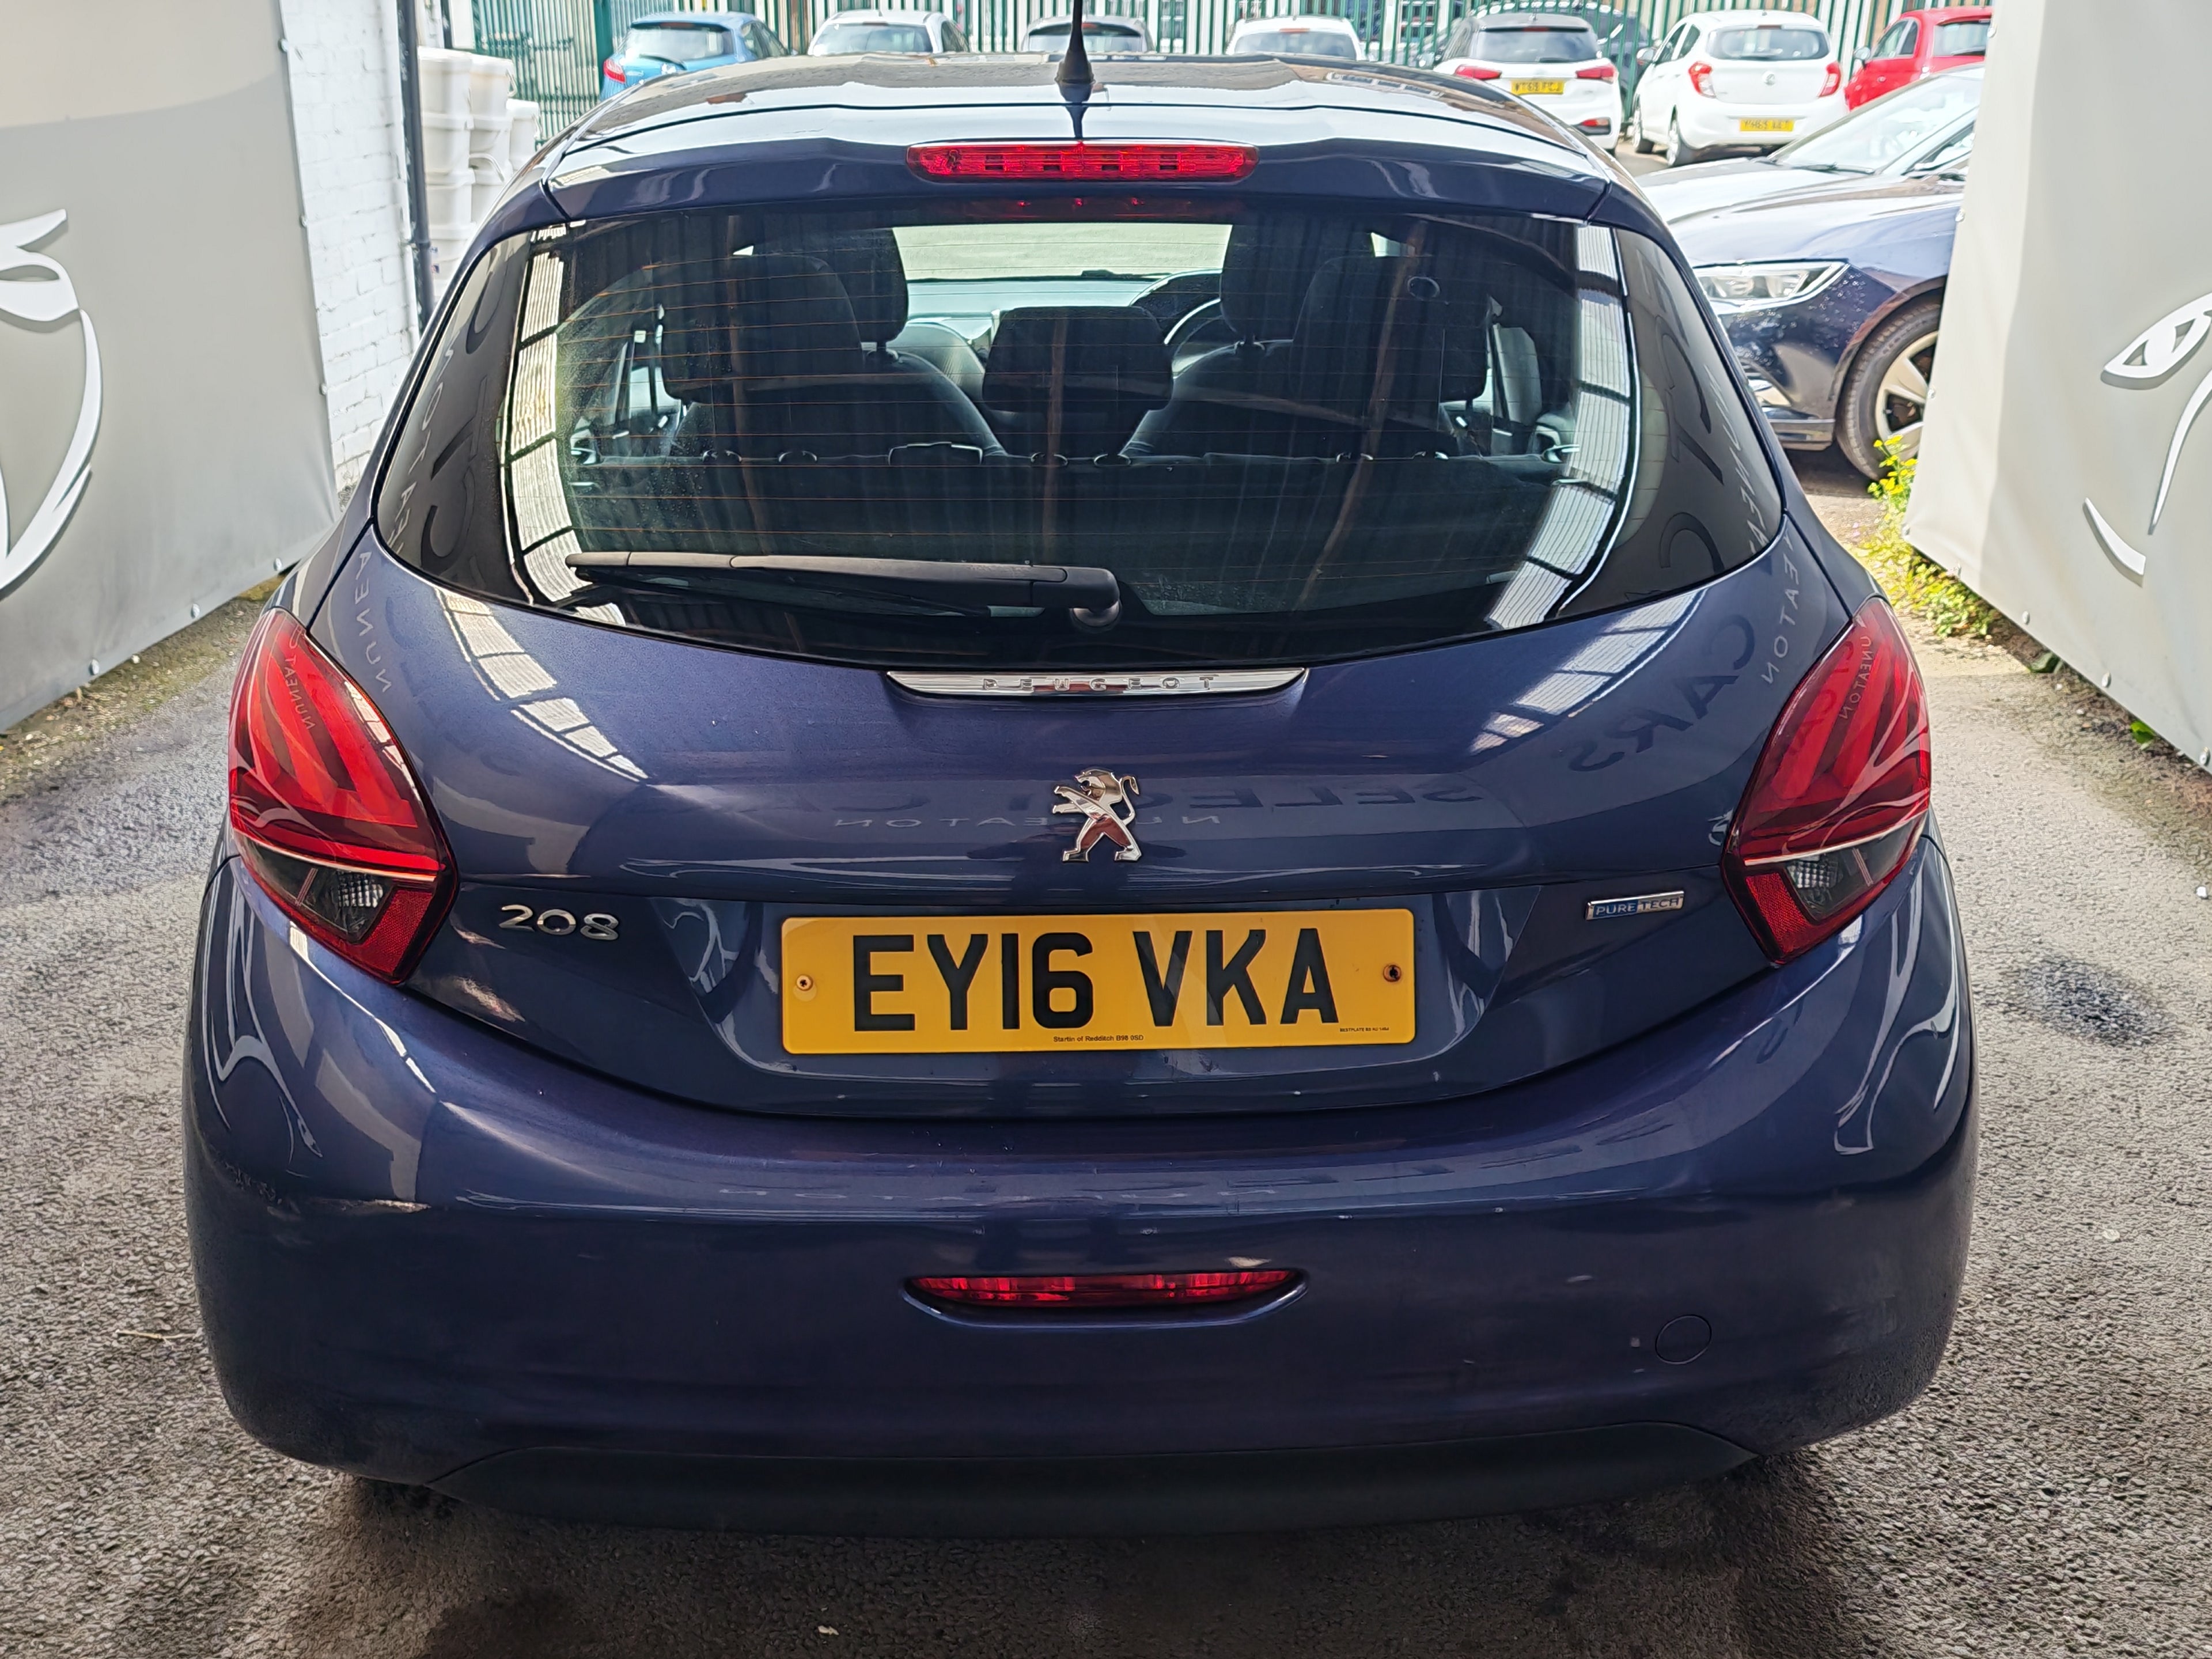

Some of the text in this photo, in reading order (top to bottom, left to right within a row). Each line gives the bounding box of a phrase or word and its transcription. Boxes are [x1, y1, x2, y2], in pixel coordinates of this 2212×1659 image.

[982, 674, 1218, 691] PEUGEOT
[498, 904, 619, 941] 208
[853, 928, 1339, 1032] EY16 VKA
